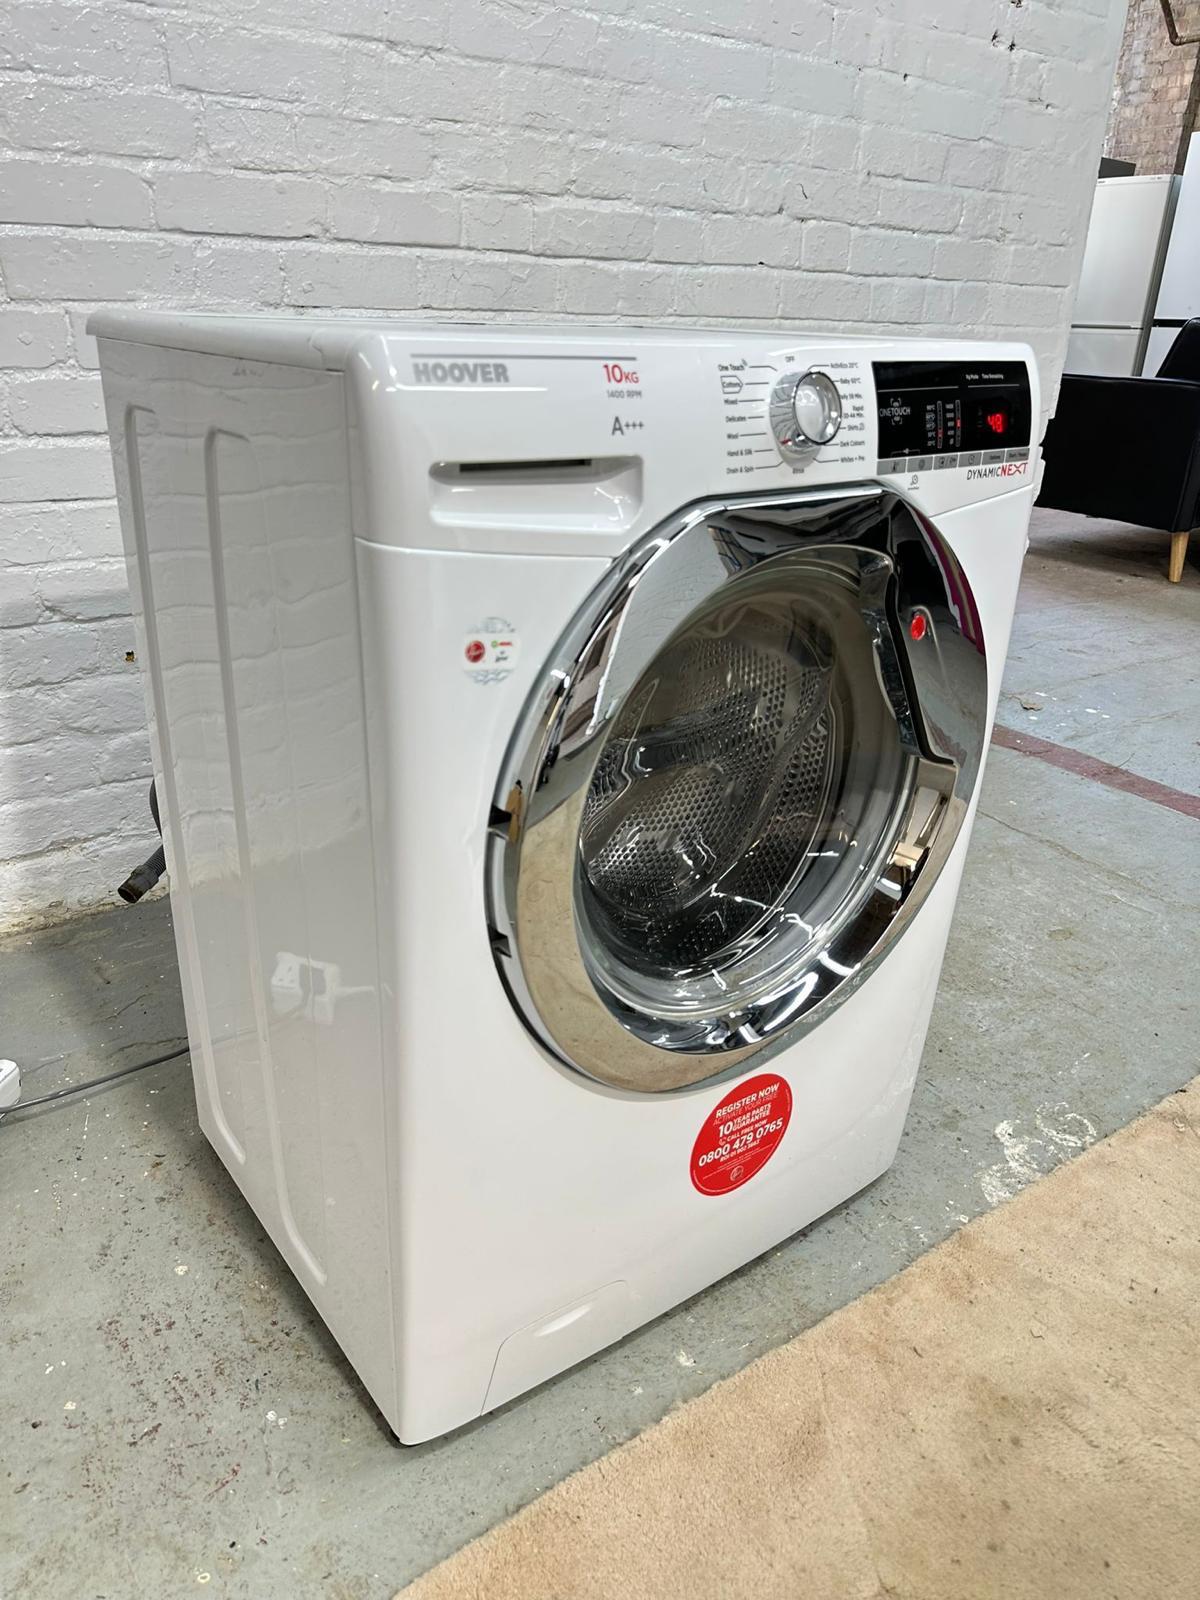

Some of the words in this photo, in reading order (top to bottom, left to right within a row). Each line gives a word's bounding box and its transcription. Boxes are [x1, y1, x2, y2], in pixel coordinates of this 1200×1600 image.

[413, 363, 510, 383] HOOVER
[603, 364, 640, 384] 10KG
[606, 390, 625, 399] 1400
[626, 390, 642, 399] RPM
[879, 406, 911, 416] ONETOUCH
[612, 416, 645, 436] A+++
[713, 1107, 743, 1127] ACTIVATE
[744, 1099, 762, 1114] YOUR
[762, 1092, 778, 1104] FREE
[716, 1093, 756, 1118] REGISTER
[758, 1082, 780, 1098] NOW
[719, 1121, 733, 1138] 10
[734, 1113, 750, 1126] YEAR
[750, 1103, 772, 1117] PARTS
[727, 1132, 740, 1142] CALL
[741, 1126, 754, 1136] FREE
[755, 1120, 768, 1130] NOW
[732, 1110, 771, 1131] GUARANTEE
[698, 1144, 730, 1167] 0800
[732, 1133, 753, 1150] 479
[756, 1118, 784, 1138] 0765
